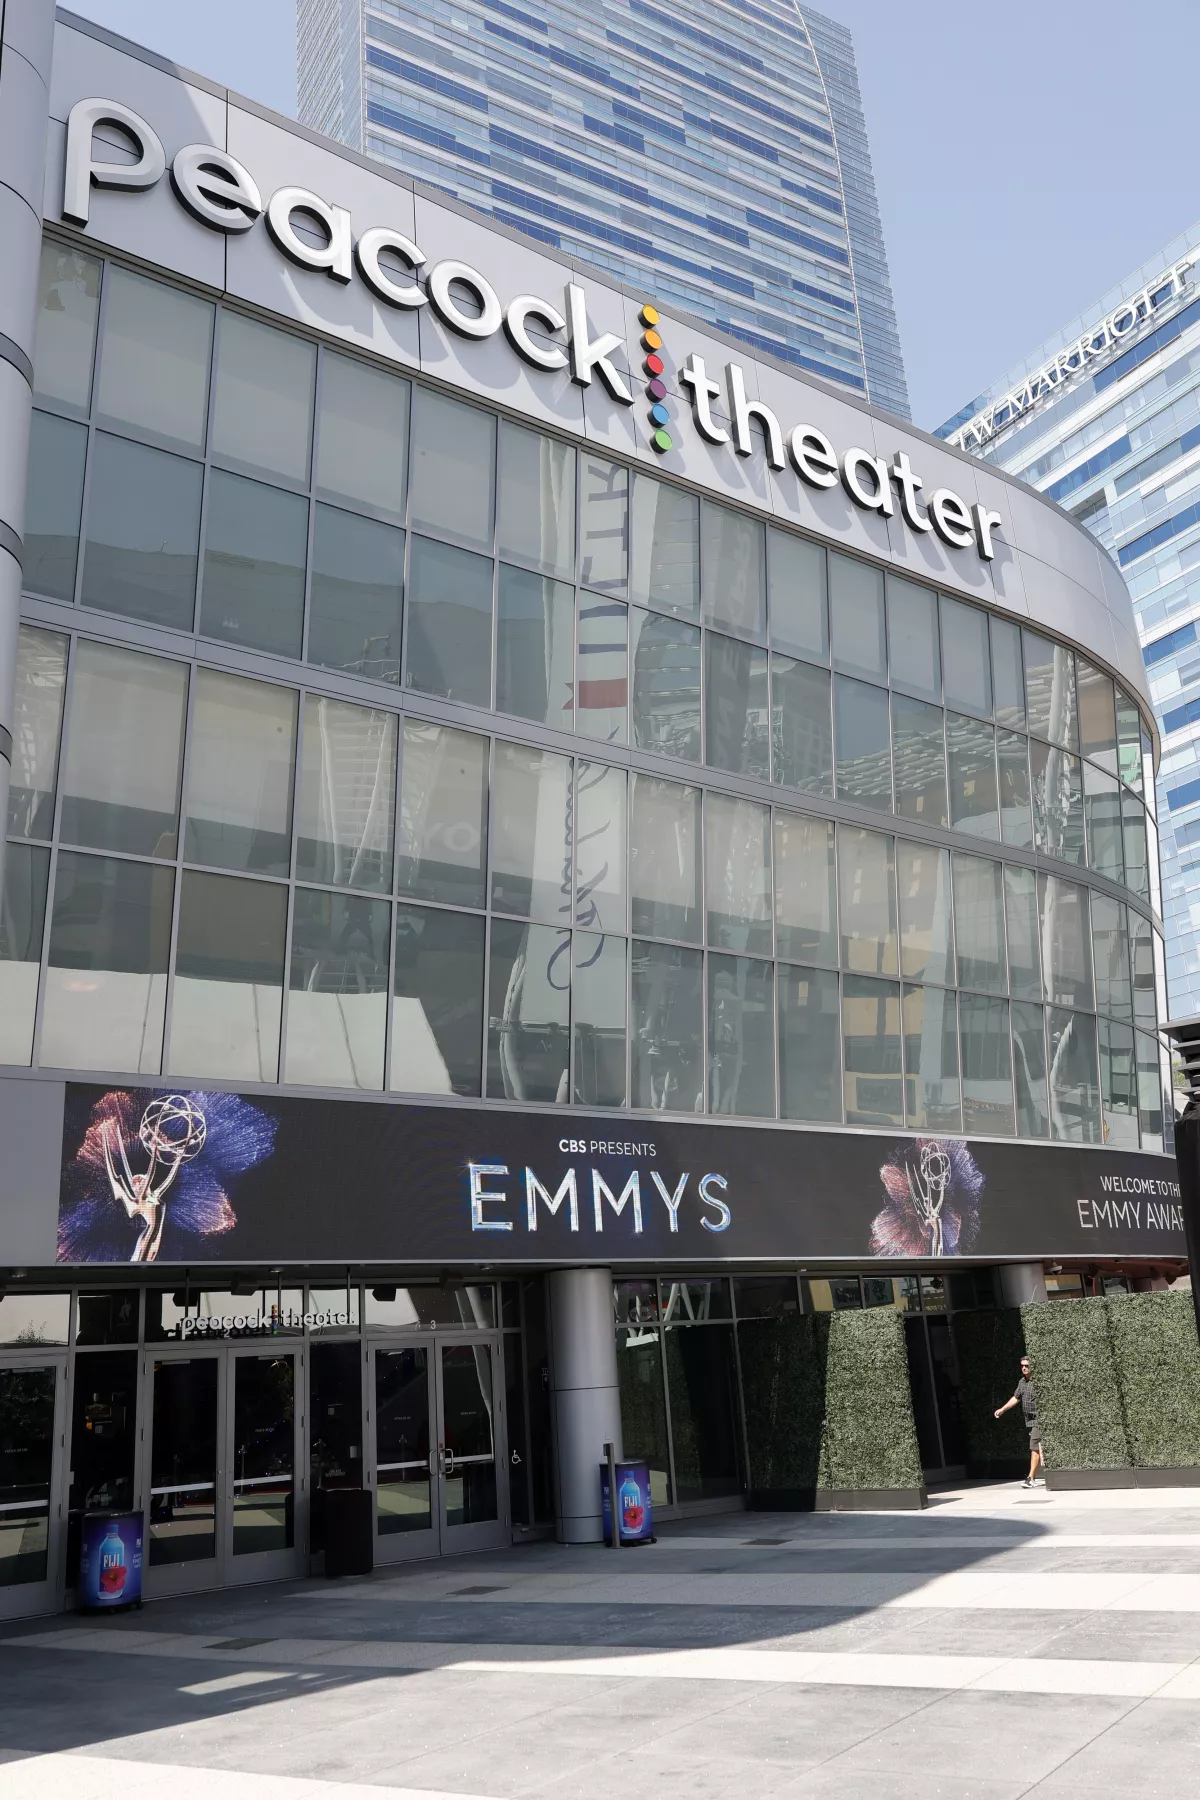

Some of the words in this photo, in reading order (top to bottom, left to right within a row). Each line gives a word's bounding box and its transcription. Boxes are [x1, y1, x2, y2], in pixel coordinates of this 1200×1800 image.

[60, 97, 634, 405] peacock
[679, 352, 1001, 561] theater
[1005, 258, 1195, 421] MARRIOTT
[559, 1139, 587, 1153] CBS
[590, 1140, 657, 1157] PRESENTS
[469, 1163, 731, 1233] EMMYS
[1100, 1175, 1157, 1195] WELCOME
[1156, 1180, 1168, 1196] TO
[1077, 1199, 1140, 1229] EMMY
[180, 1308, 270, 1340] peacock
[281, 1308, 355, 1328] theater
[430, 1319, 436, 1330] 3
[624, 1495, 638, 1508] FIJI
[103, 1553, 120, 1568] FIJI
